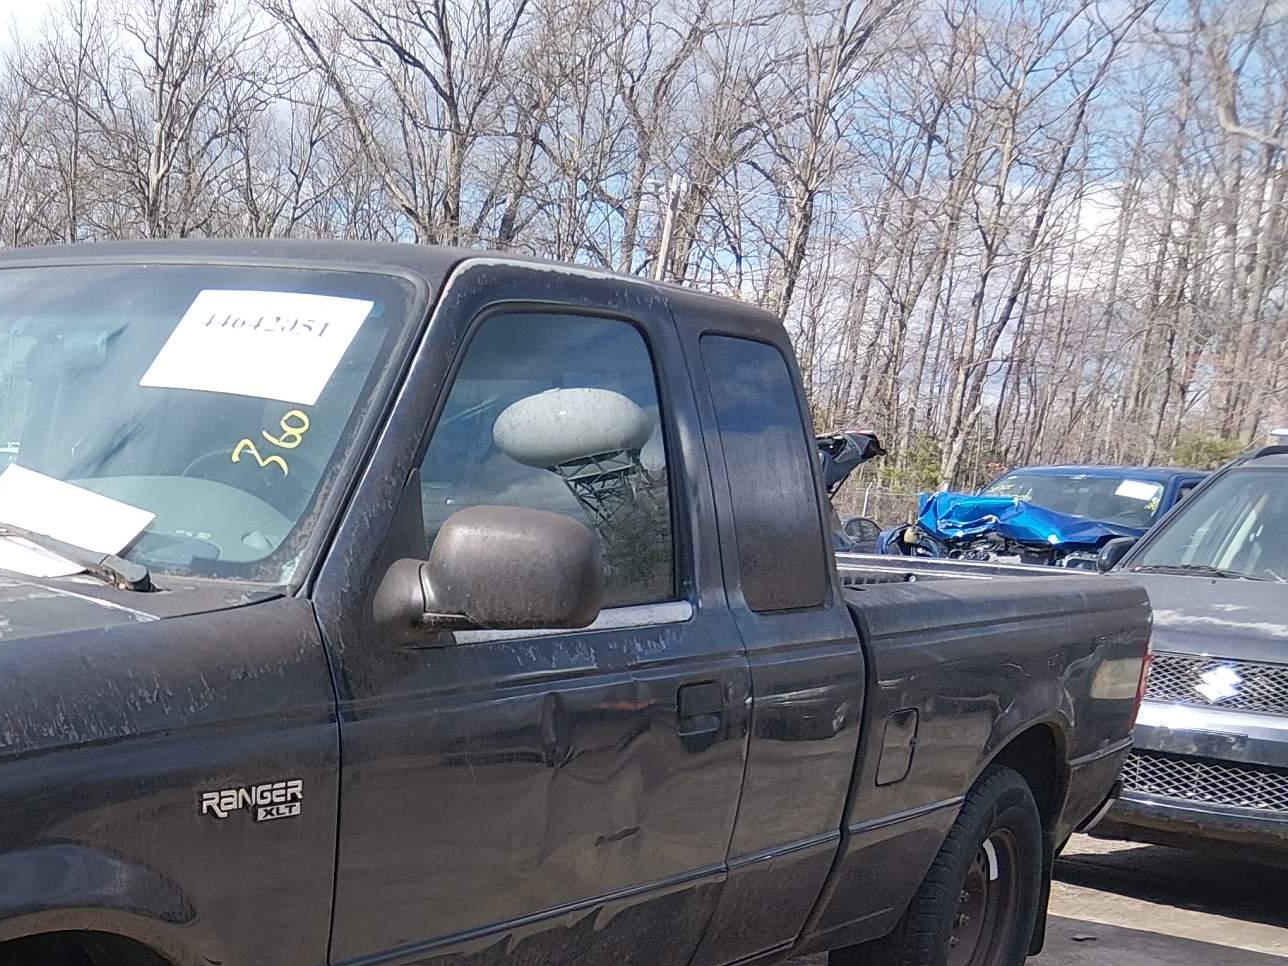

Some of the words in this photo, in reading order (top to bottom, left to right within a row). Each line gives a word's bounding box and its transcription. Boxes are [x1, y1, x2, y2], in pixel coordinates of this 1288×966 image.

[231, 409, 310, 478] 360
[202, 779, 304, 818] RANGER
[262, 803, 298, 819] XLT
